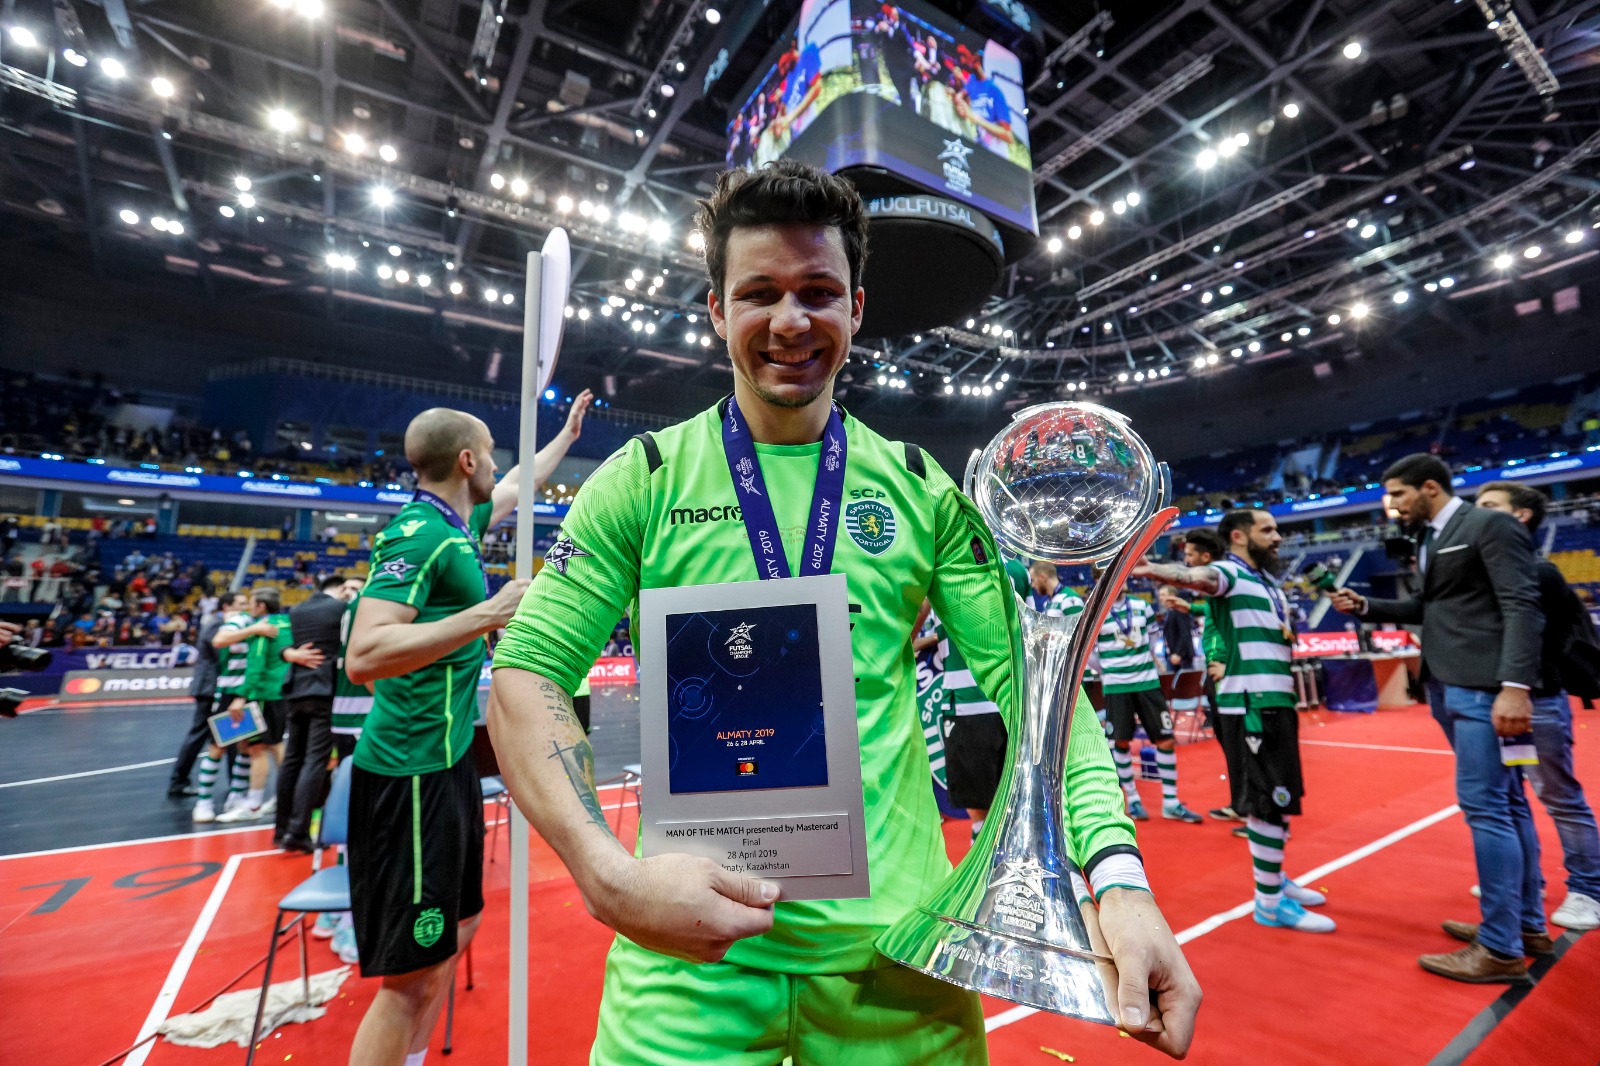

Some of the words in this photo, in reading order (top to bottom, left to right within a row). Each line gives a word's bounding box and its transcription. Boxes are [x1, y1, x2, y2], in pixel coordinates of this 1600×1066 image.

[869, 197, 976, 228] #UCLFUTSAL
[850, 489, 886, 499] SCP
[850, 504, 890, 517] SPORTING
[817, 498, 831, 542] ALMATY
[759, 530, 773, 554] 2019
[854, 536, 891, 547] PORTUGAL
[811, 544, 824, 570] 2019
[766, 558, 780, 578] ATY
[103, 676, 194, 692] master
[1160, 711, 1173, 730] 6
[716, 730, 752, 740] ALMATY
[754, 728, 775, 738] 2019
[666, 829, 685, 837] MAN
[686, 828, 697, 837] OF
[699, 827, 715, 836] THE
[716, 826, 744, 835] MATCH
[746, 825, 783, 836] presented
[785, 824, 795, 833] by
[796, 822, 839, 832] Mastercard
[742, 838, 761, 846] Final
[727, 851, 737, 859] 28
[738, 850, 757, 860] April
[758, 849, 778, 858] 2019
[722, 864, 745, 873] maty,
[746, 862, 790, 871] Kazakhstan
[995, 893, 1044, 915] FUTSAL
[942, 941, 1034, 980] WINNERS
